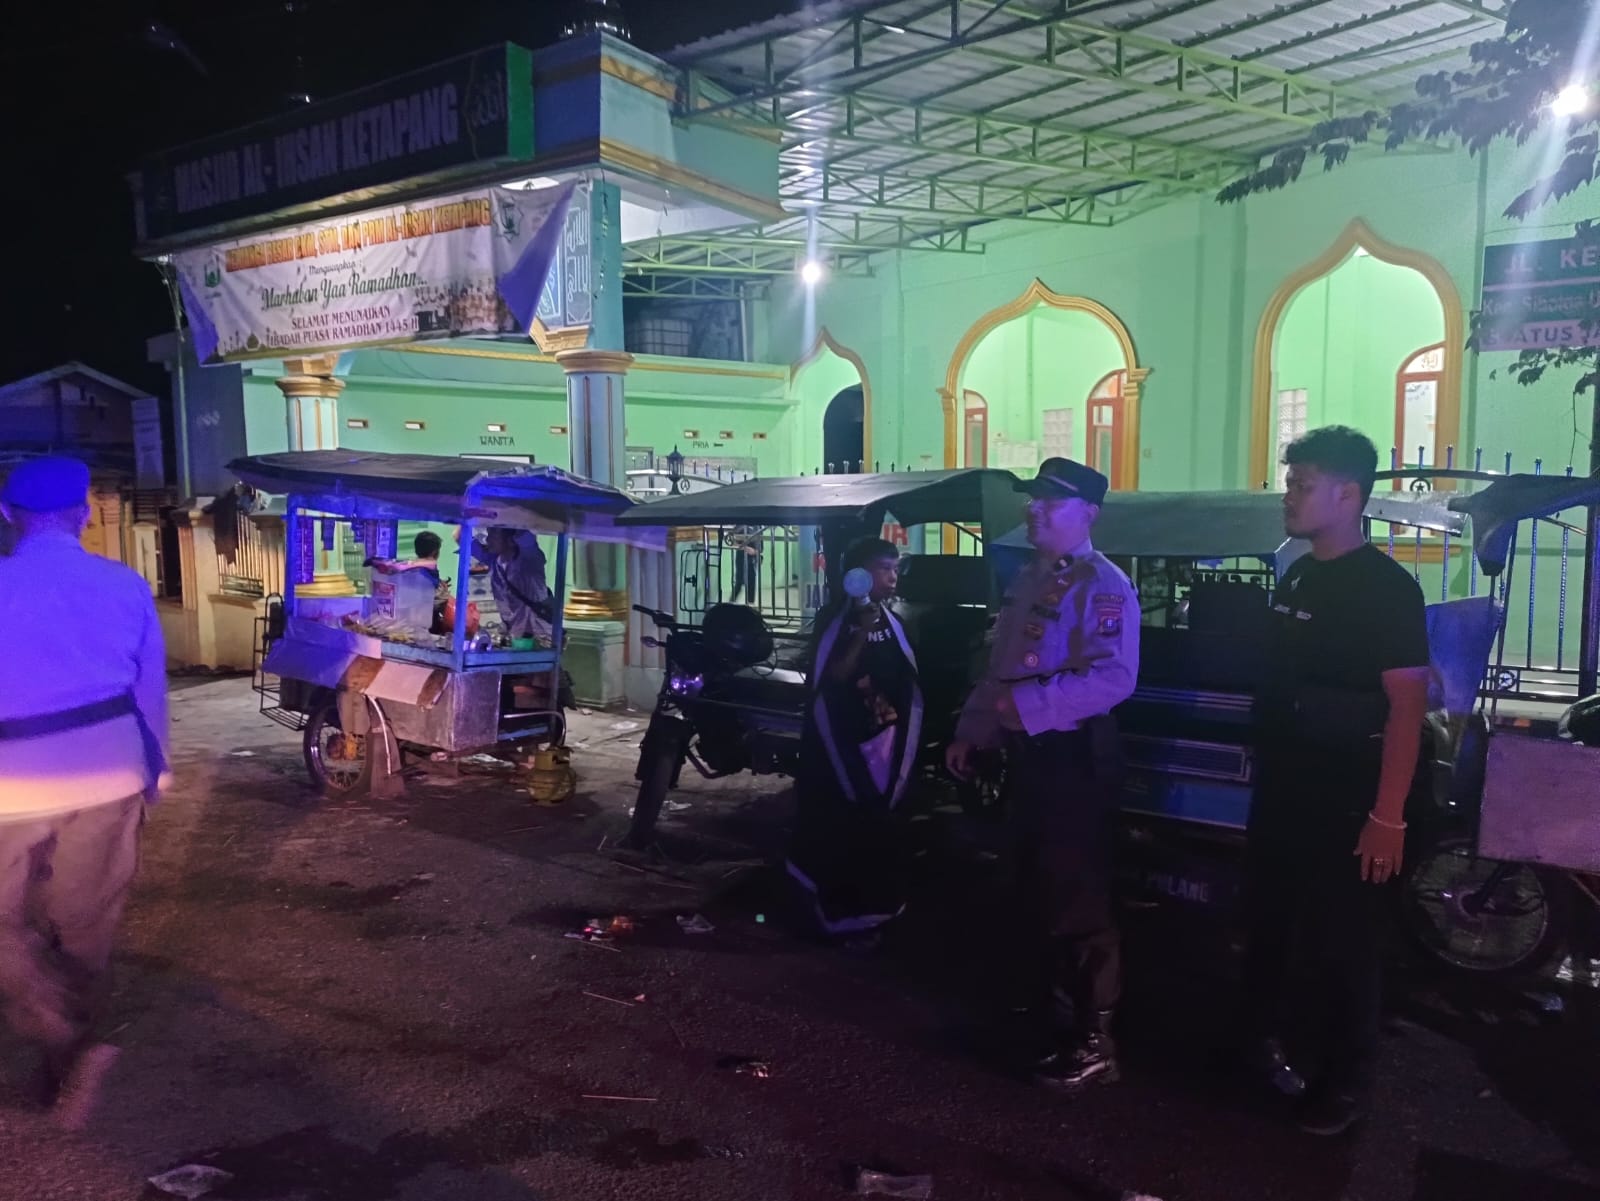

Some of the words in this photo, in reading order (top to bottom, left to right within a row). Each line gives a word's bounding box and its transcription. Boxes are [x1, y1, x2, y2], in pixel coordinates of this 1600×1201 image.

[341, 81, 459, 172] KETAPANG
[434, 197, 491, 233] KETAPANG
[261, 283, 318, 311] Marhaban
[320, 278, 346, 310] Yaa
[292, 314, 330, 330] SELAMAT
[332, 305, 391, 325] MENUNAIKAN
[303, 328, 331, 345] PUASA
[333, 324, 382, 341] RAMADHAN
[385, 319, 408, 334] 1445
[411, 316, 418, 331] H
[1485, 326, 1573, 346] SATUS
[480, 435, 515, 447] WANITA
